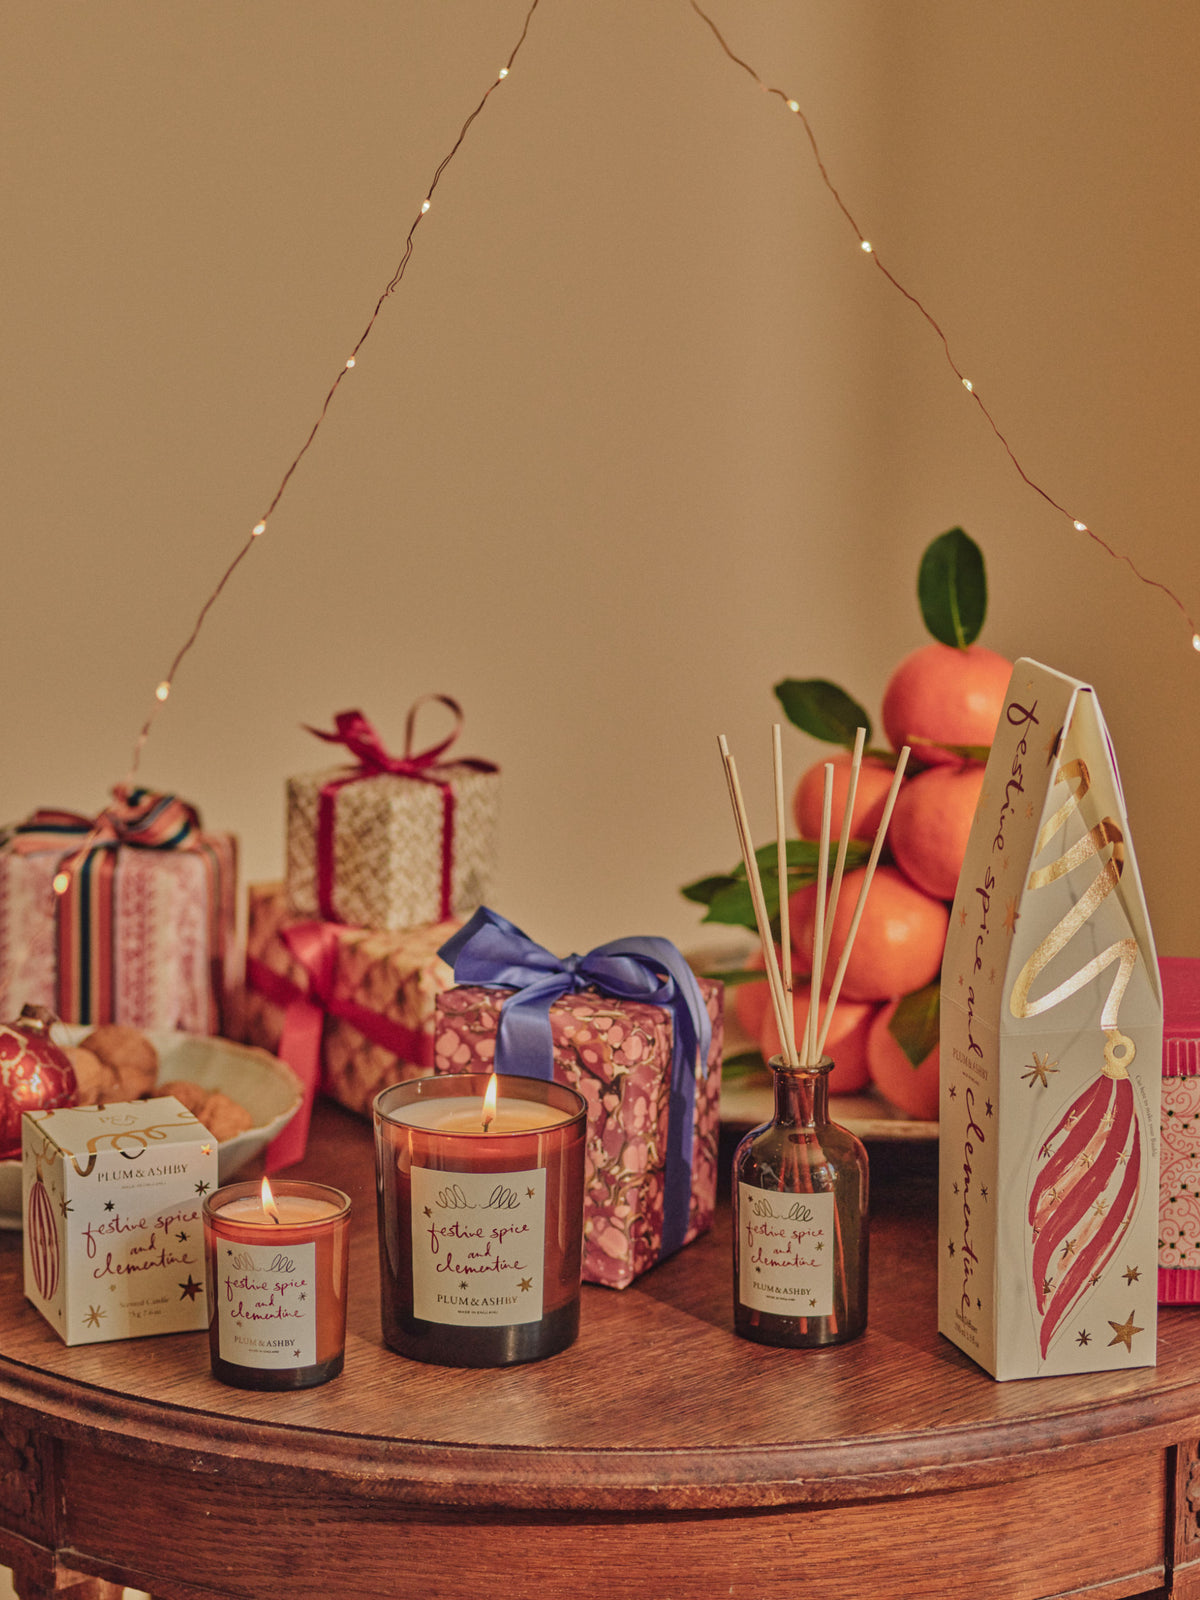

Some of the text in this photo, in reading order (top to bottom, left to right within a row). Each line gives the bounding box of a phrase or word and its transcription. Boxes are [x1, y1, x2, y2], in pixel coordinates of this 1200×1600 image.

[973, 865, 996, 974] spice
[966, 986, 984, 1061] and
[81, 1209, 201, 1258] festive spice
[130, 1235, 156, 1255] and
[426, 1221, 530, 1254] festive spice
[745, 1221, 825, 1248] festive spice
[467, 1241, 491, 1259] and
[751, 1247, 823, 1268] clementine
[773, 1241, 792, 1254] and
[93, 1251, 199, 1279] clementine
[436, 1252, 528, 1275] clementine
[224, 1275, 308, 1301] festive spice
[230, 1301, 305, 1321] clementine
[254, 1294, 275, 1309] and
